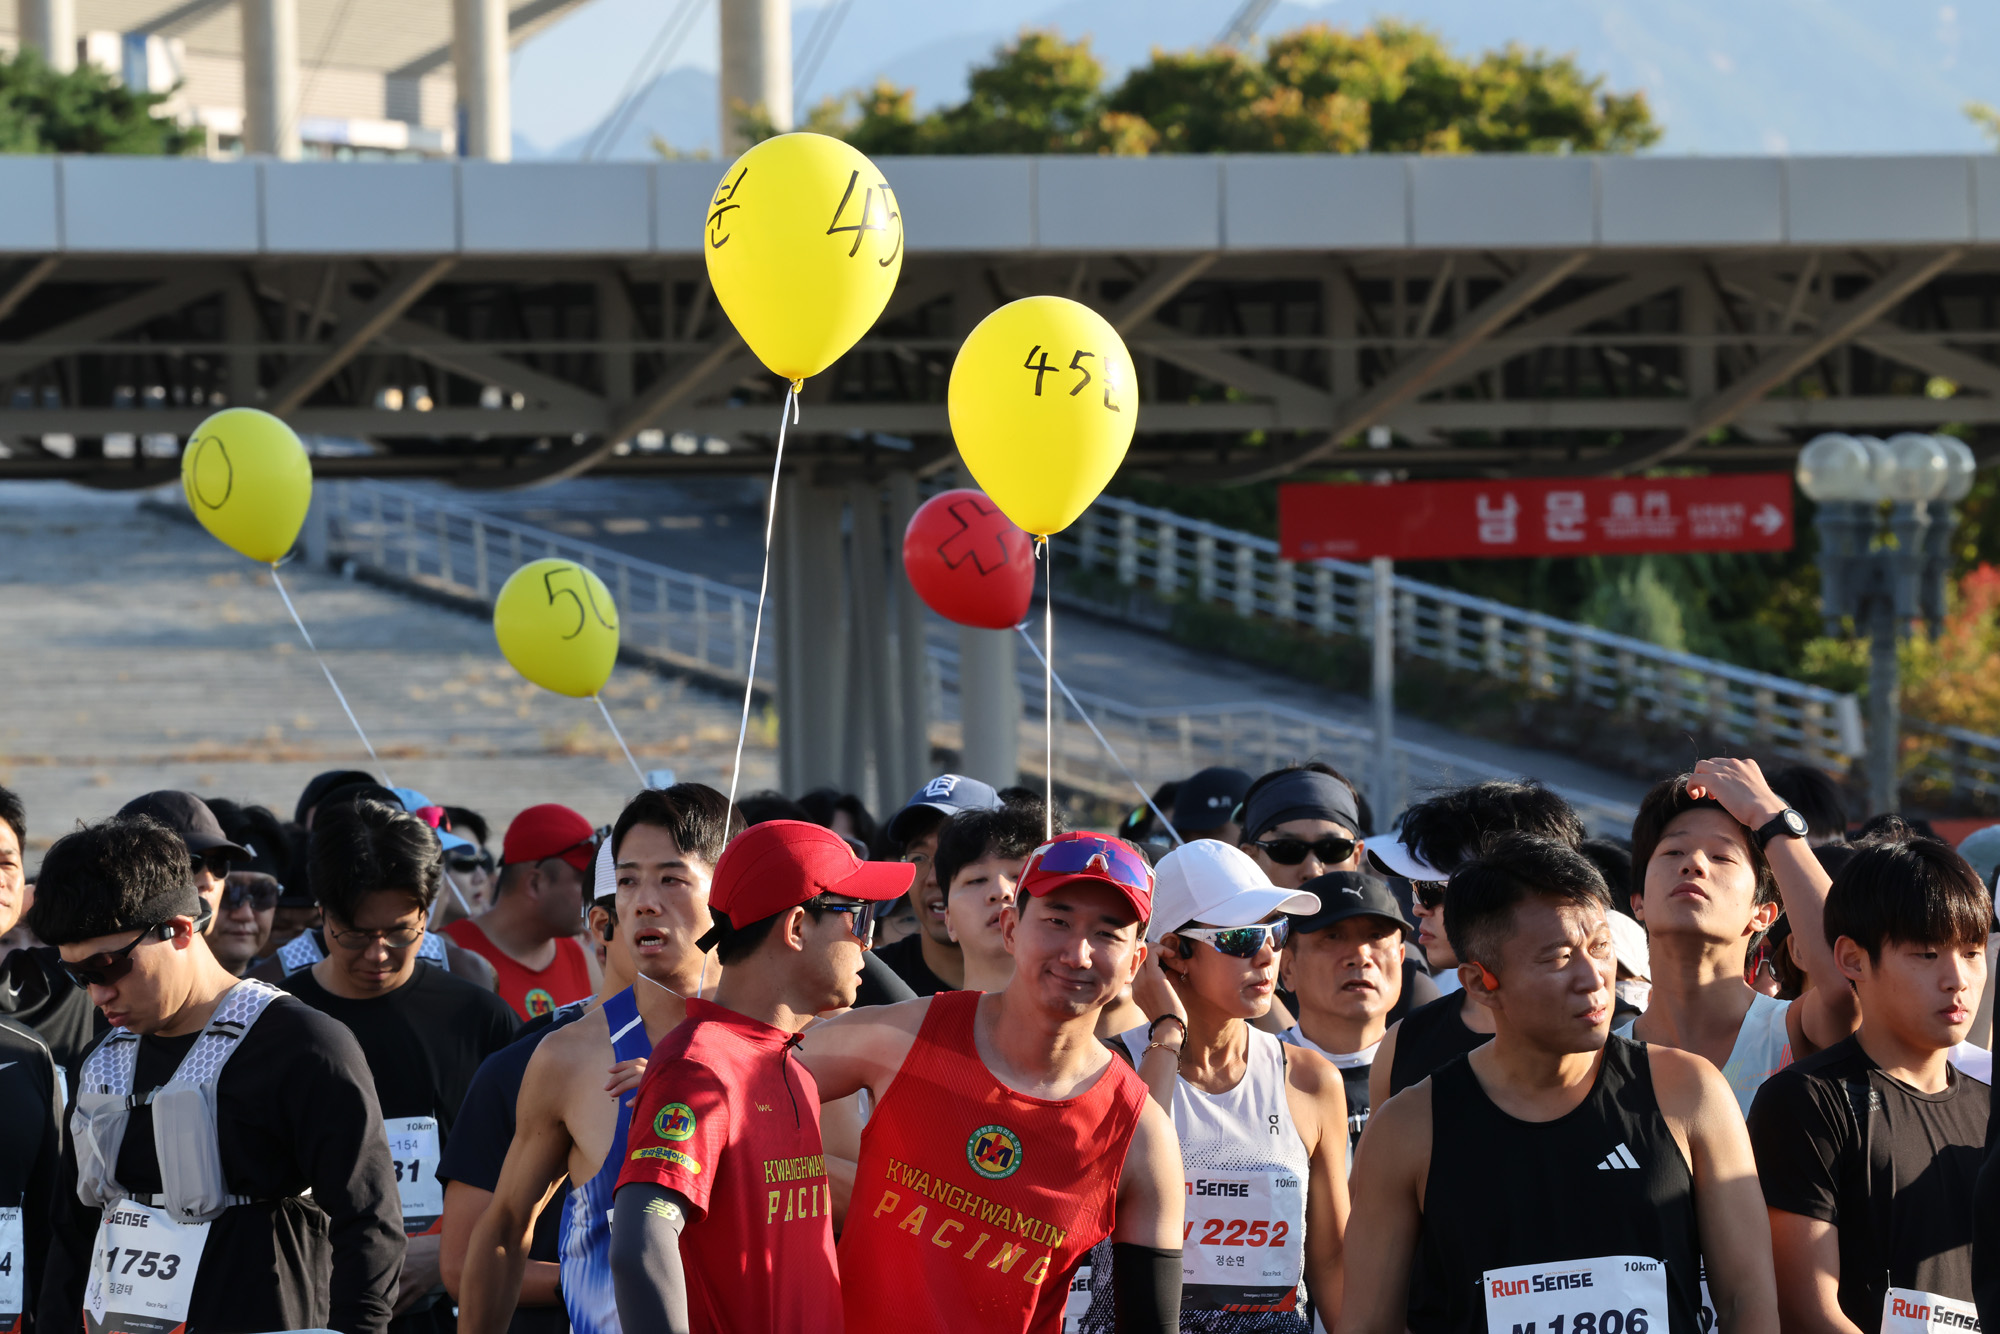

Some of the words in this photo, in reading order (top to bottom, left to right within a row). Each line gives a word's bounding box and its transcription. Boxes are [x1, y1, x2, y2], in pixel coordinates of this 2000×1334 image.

[707, 167, 748, 249] 분
[826, 170, 903, 267] 45
[406, 1122, 432, 1131] 10km
[1275, 1179, 1298, 1188] 10km
[885, 1157, 1067, 1249] KWANGHWAMUN
[873, 1190, 1051, 1286] PACING
[1200, 1218, 1289, 1248] 2252
[106, 1246, 181, 1280] 1753
[1216, 1255, 1245, 1267] 정순연
[1624, 1261, 1657, 1272] 10km
[109, 1282, 133, 1295] 김경태
[1548, 1308, 1649, 1334] 1806
